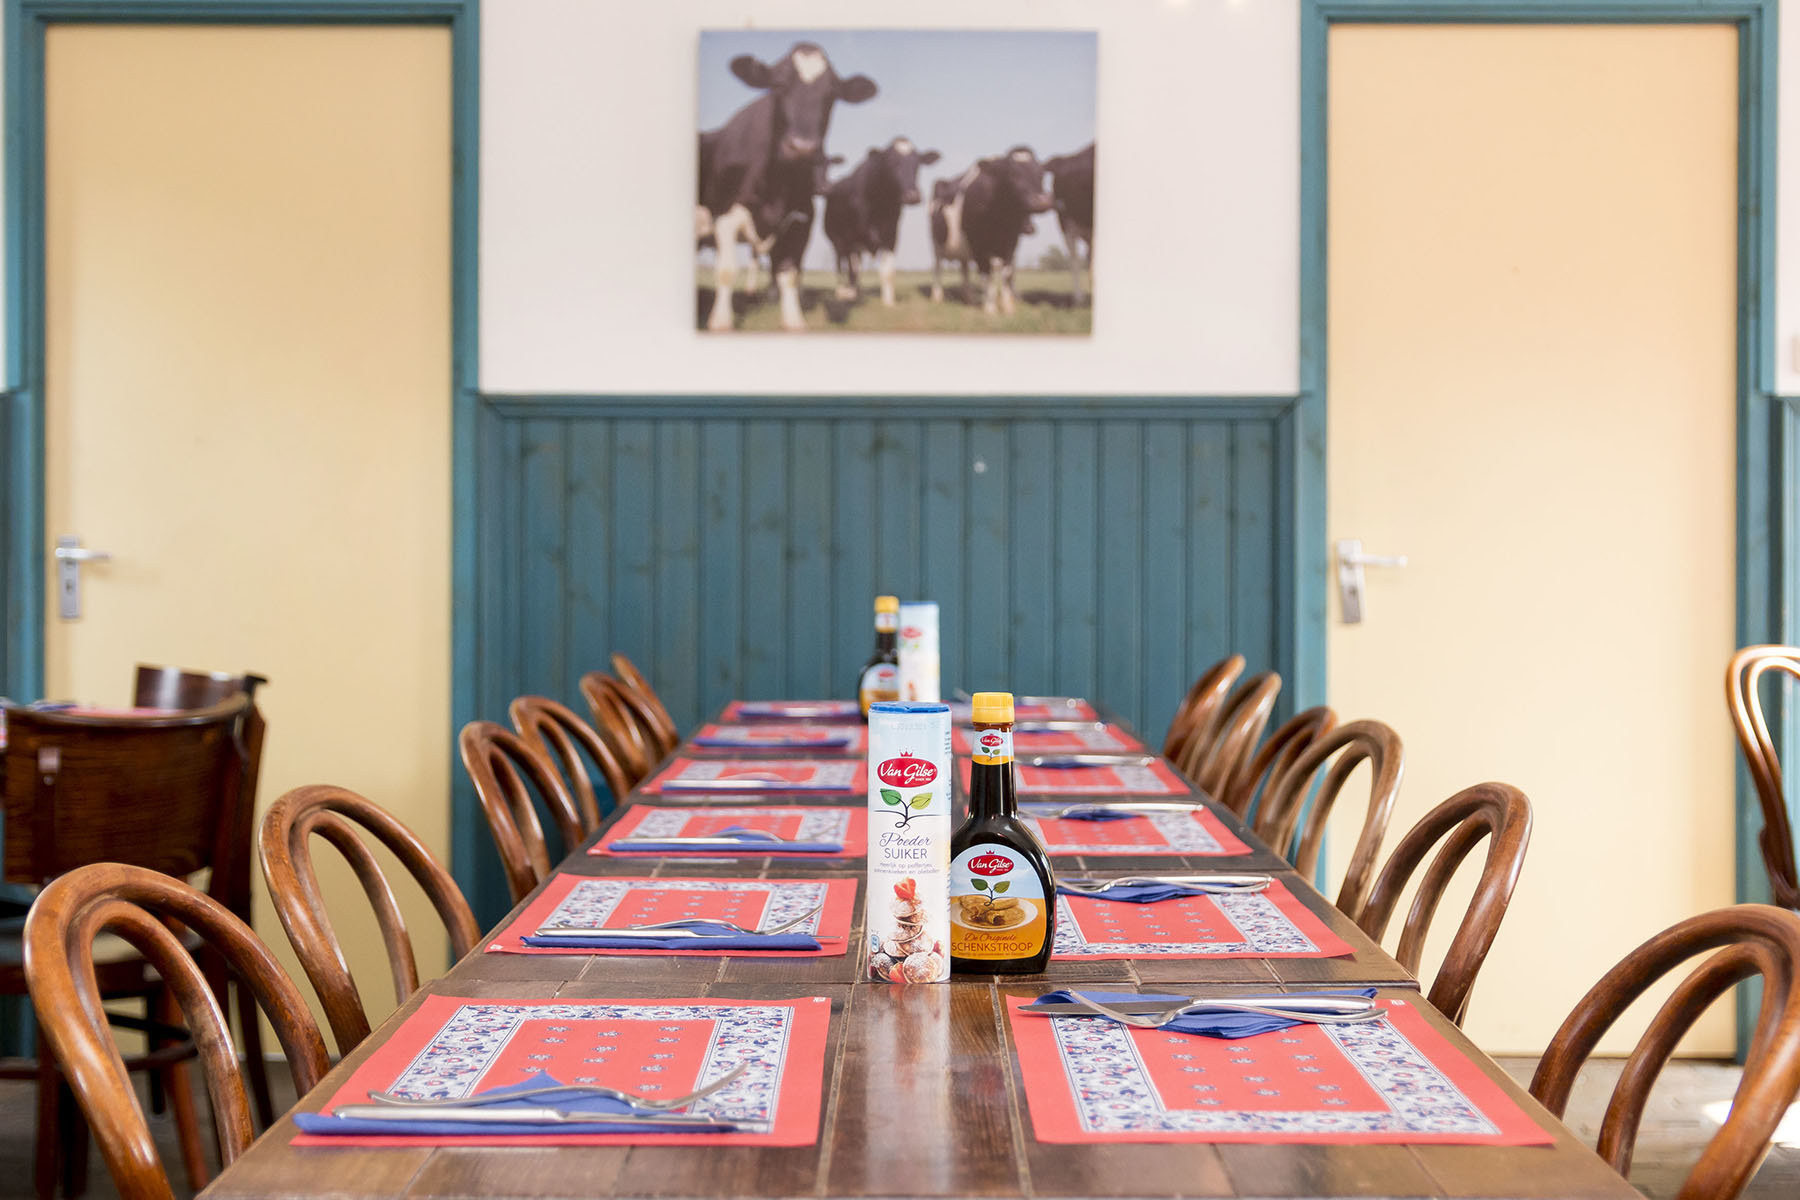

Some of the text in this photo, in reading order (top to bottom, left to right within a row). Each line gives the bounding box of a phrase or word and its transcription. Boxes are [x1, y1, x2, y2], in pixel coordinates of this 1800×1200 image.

[880, 763, 902, 777] Van
[903, 763, 934, 784] Gilse
[879, 832, 932, 847] Poeder
[884, 847, 928, 859] SUIKER
[970, 858, 1010, 874] Van Gilse
[951, 942, 1033, 952] SCHENKSTROOP
